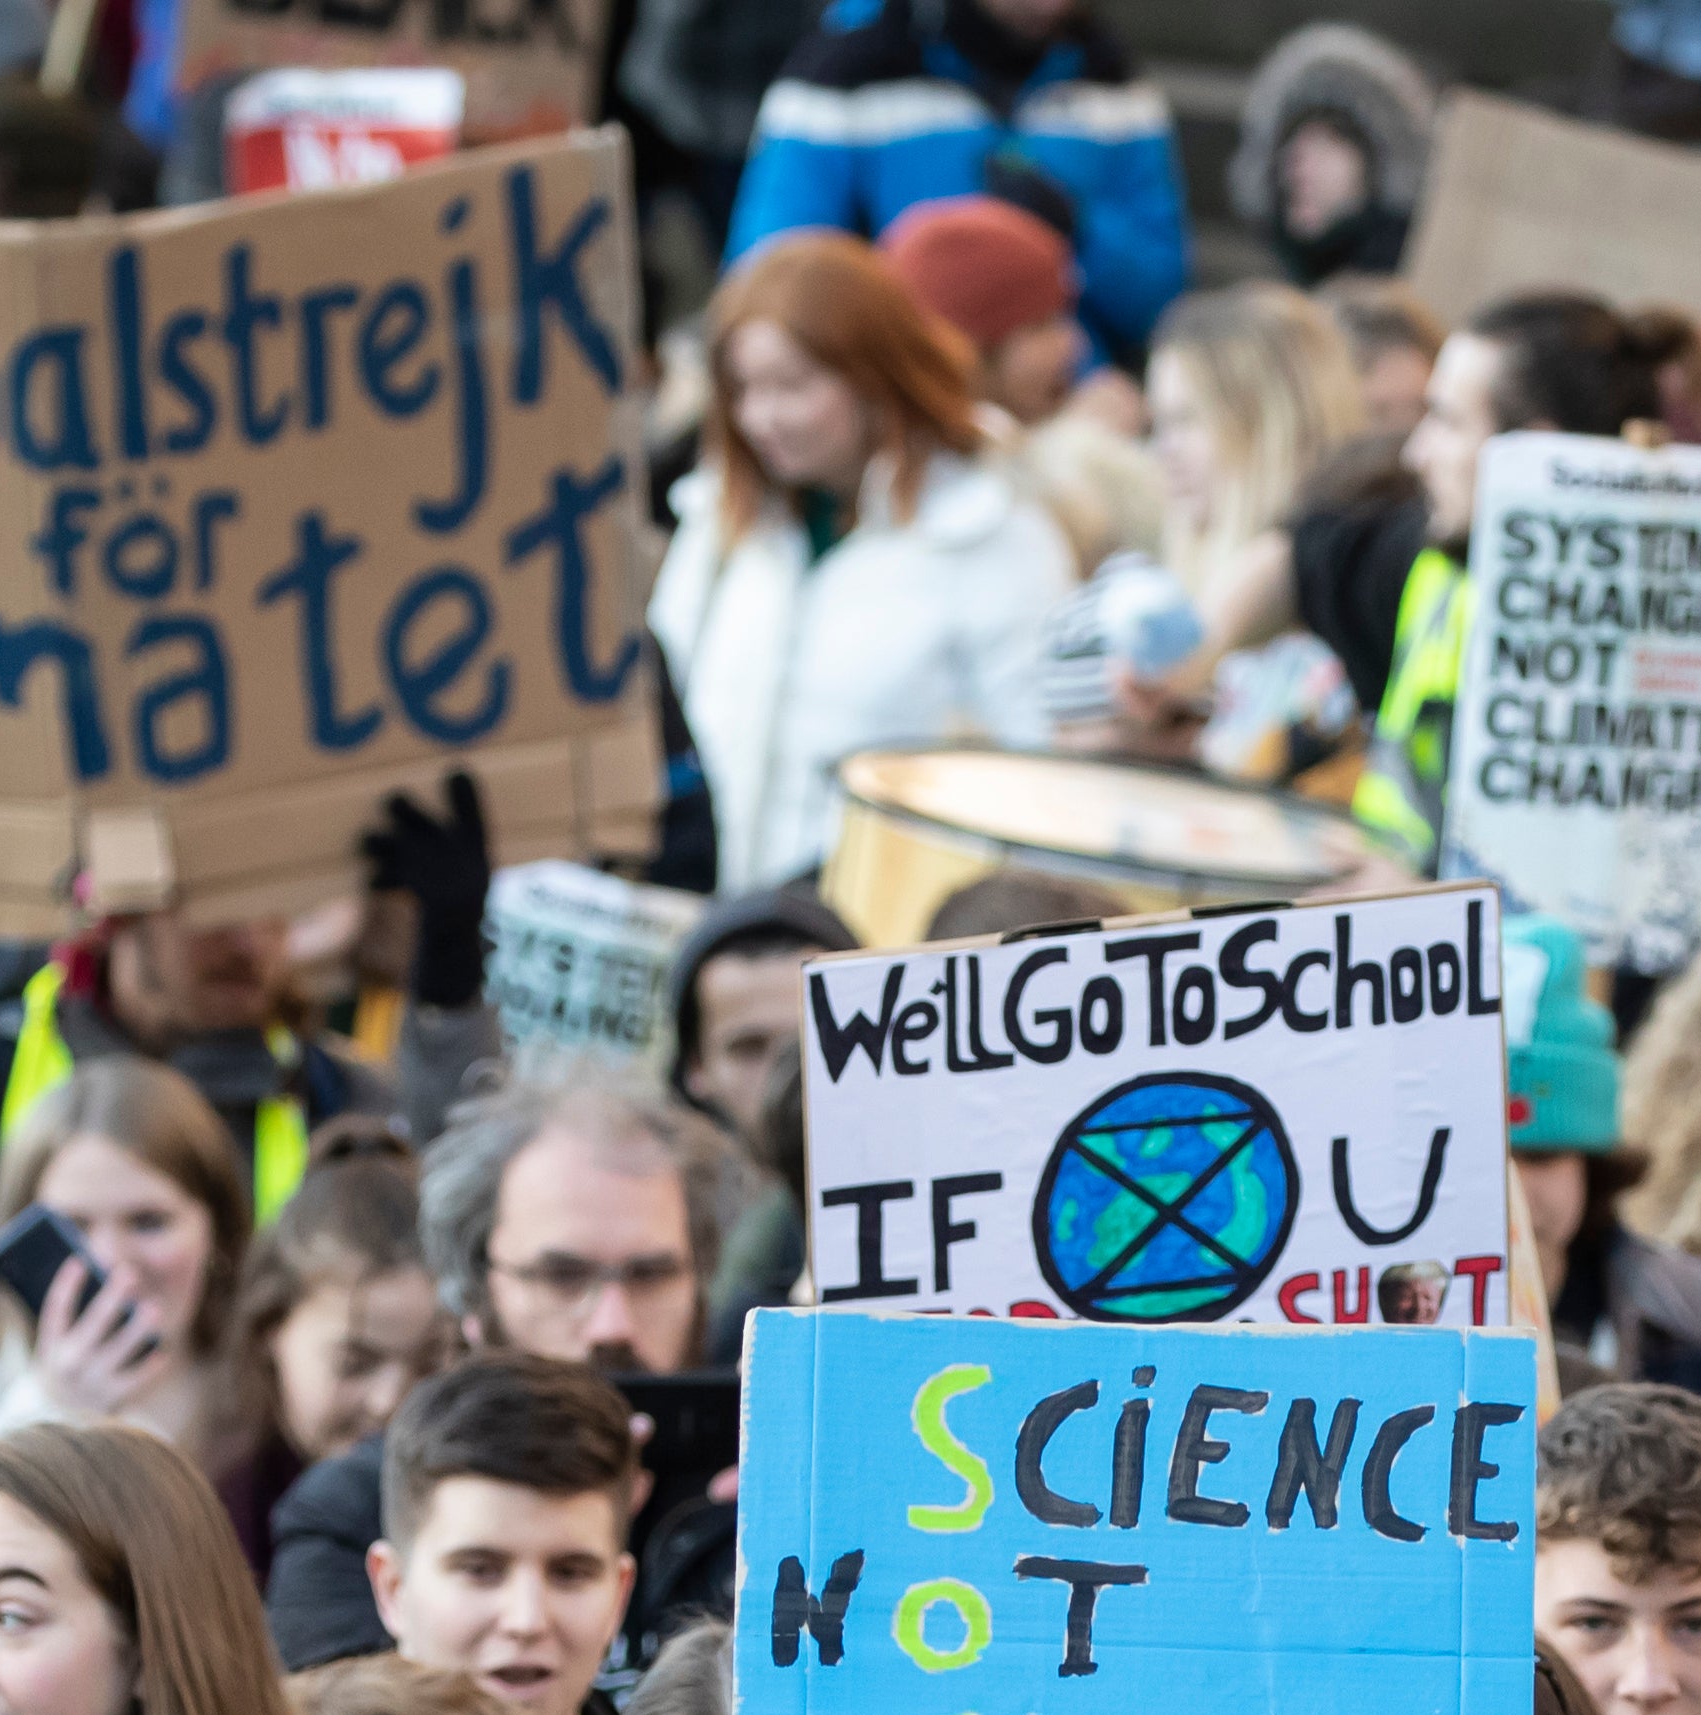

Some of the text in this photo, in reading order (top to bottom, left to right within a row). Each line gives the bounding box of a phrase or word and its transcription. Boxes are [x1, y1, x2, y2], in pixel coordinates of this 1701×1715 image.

[35, 478, 241, 600] för
[1490, 635, 1619, 687] NOT
[821, 1126, 1452, 1303] IF U
